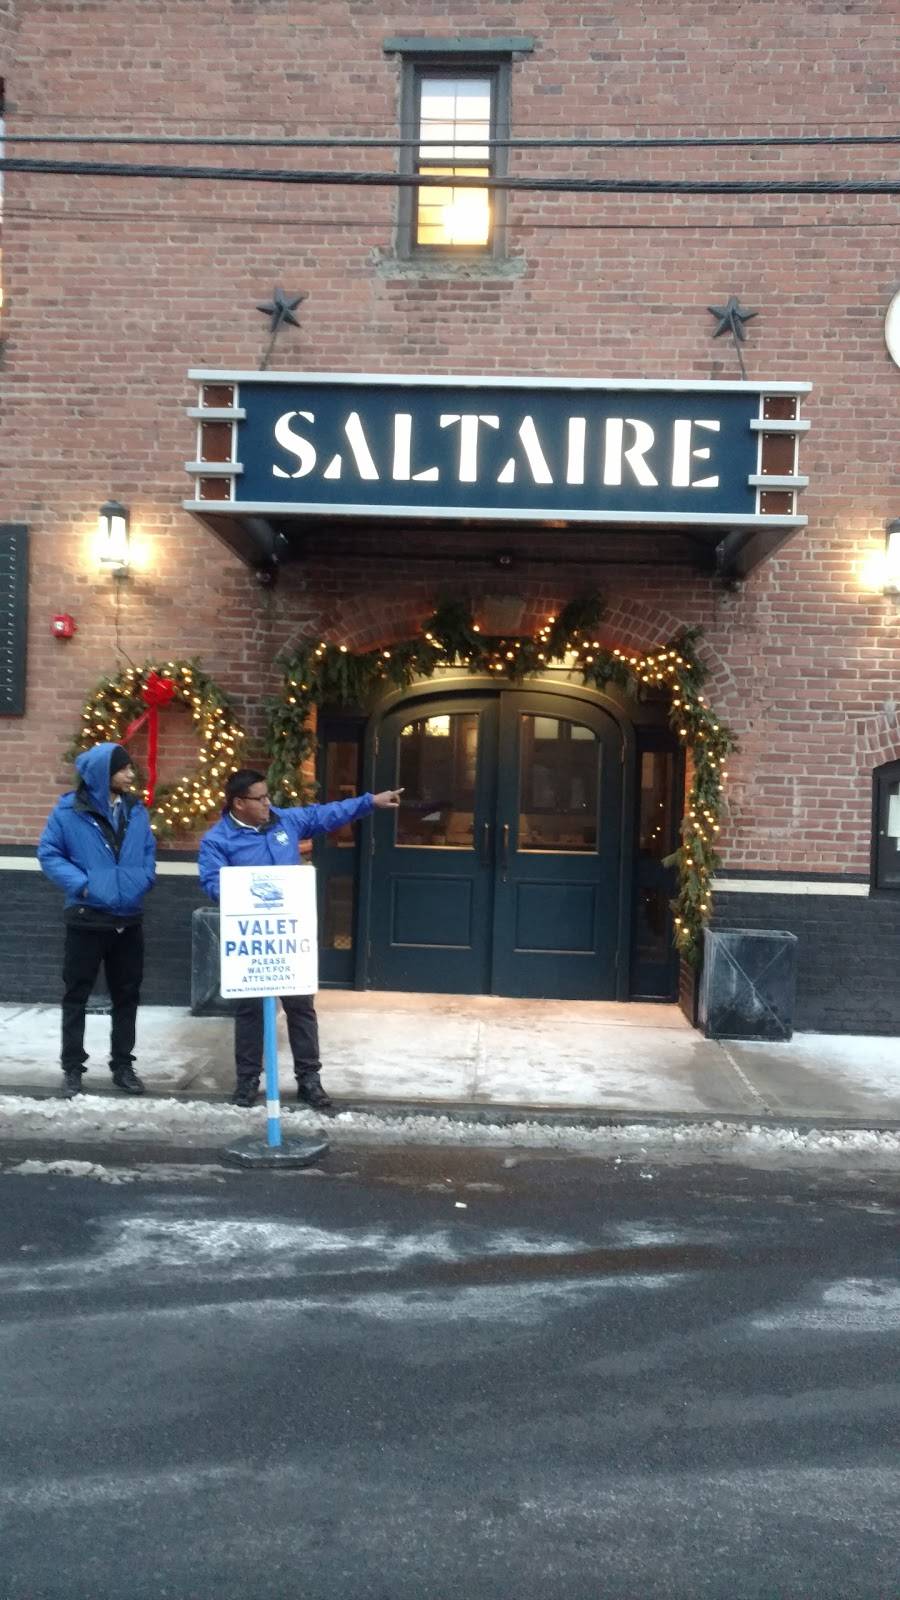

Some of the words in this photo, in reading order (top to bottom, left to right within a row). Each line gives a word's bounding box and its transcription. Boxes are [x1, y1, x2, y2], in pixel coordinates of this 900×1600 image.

[272, 410, 721, 488] SALTAIRE
[238, 919, 298, 936] VALET
[225, 938, 310, 956] PARKING
[251, 958, 286, 966] PLEASE
[248, 966, 270, 974] WAIT
[272, 965, 291, 973] FOR
[242, 973, 296, 983] ATTENDANT
